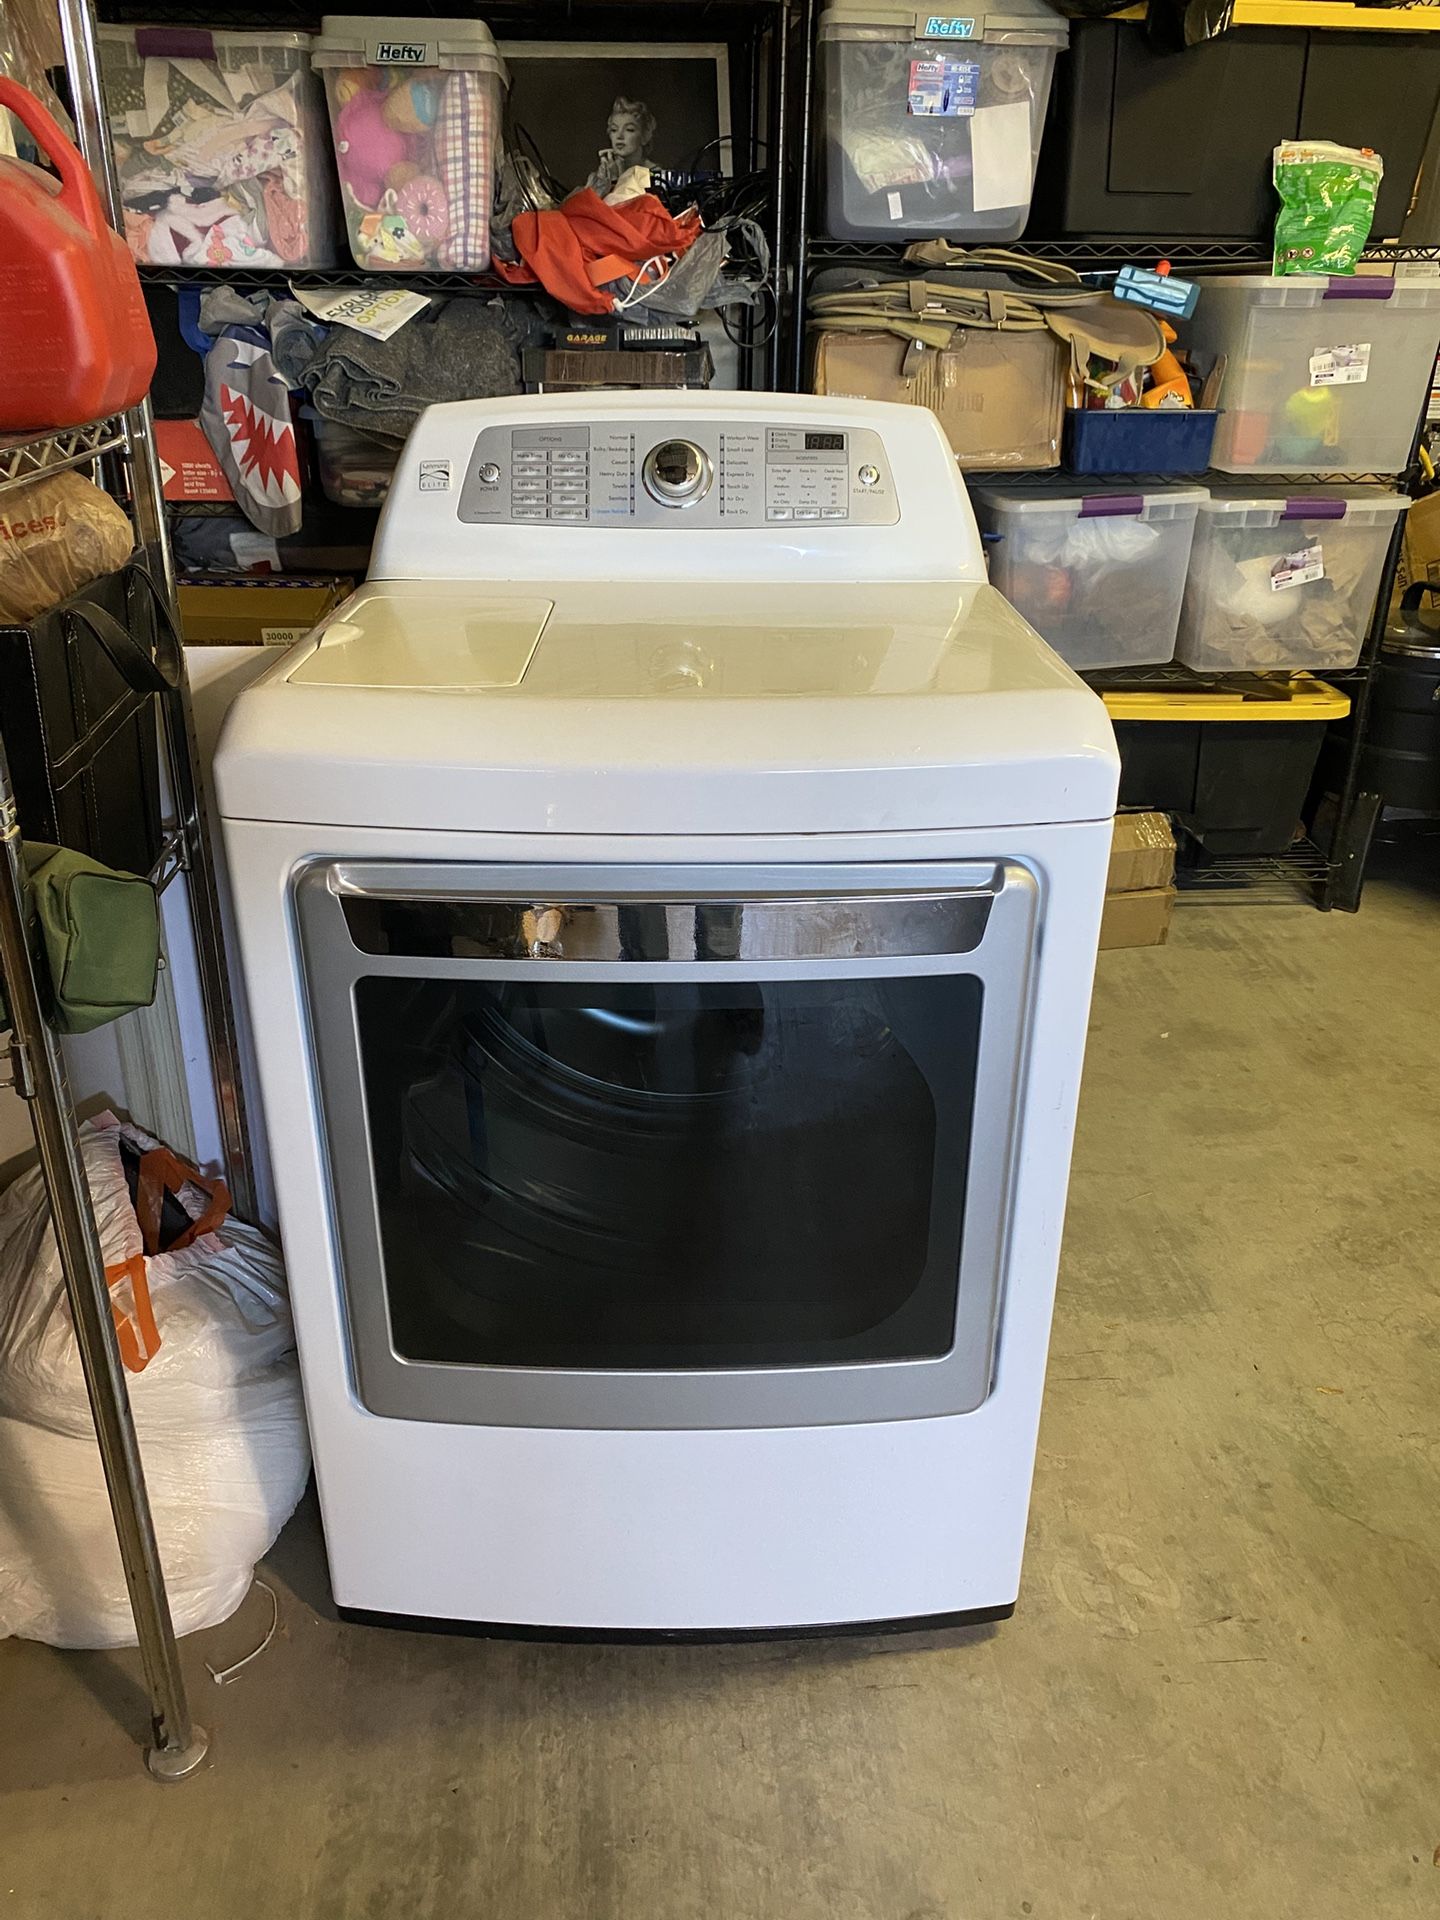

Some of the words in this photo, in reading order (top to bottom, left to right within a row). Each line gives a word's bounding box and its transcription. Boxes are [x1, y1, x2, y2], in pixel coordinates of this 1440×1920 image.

[929, 19, 970, 36] Hefty
[380, 45, 422, 61] Hefty
[918, 64, 938, 72] Hefty
[341, 295, 382, 318] YOUR
[566, 334, 607, 342] GARAGE
